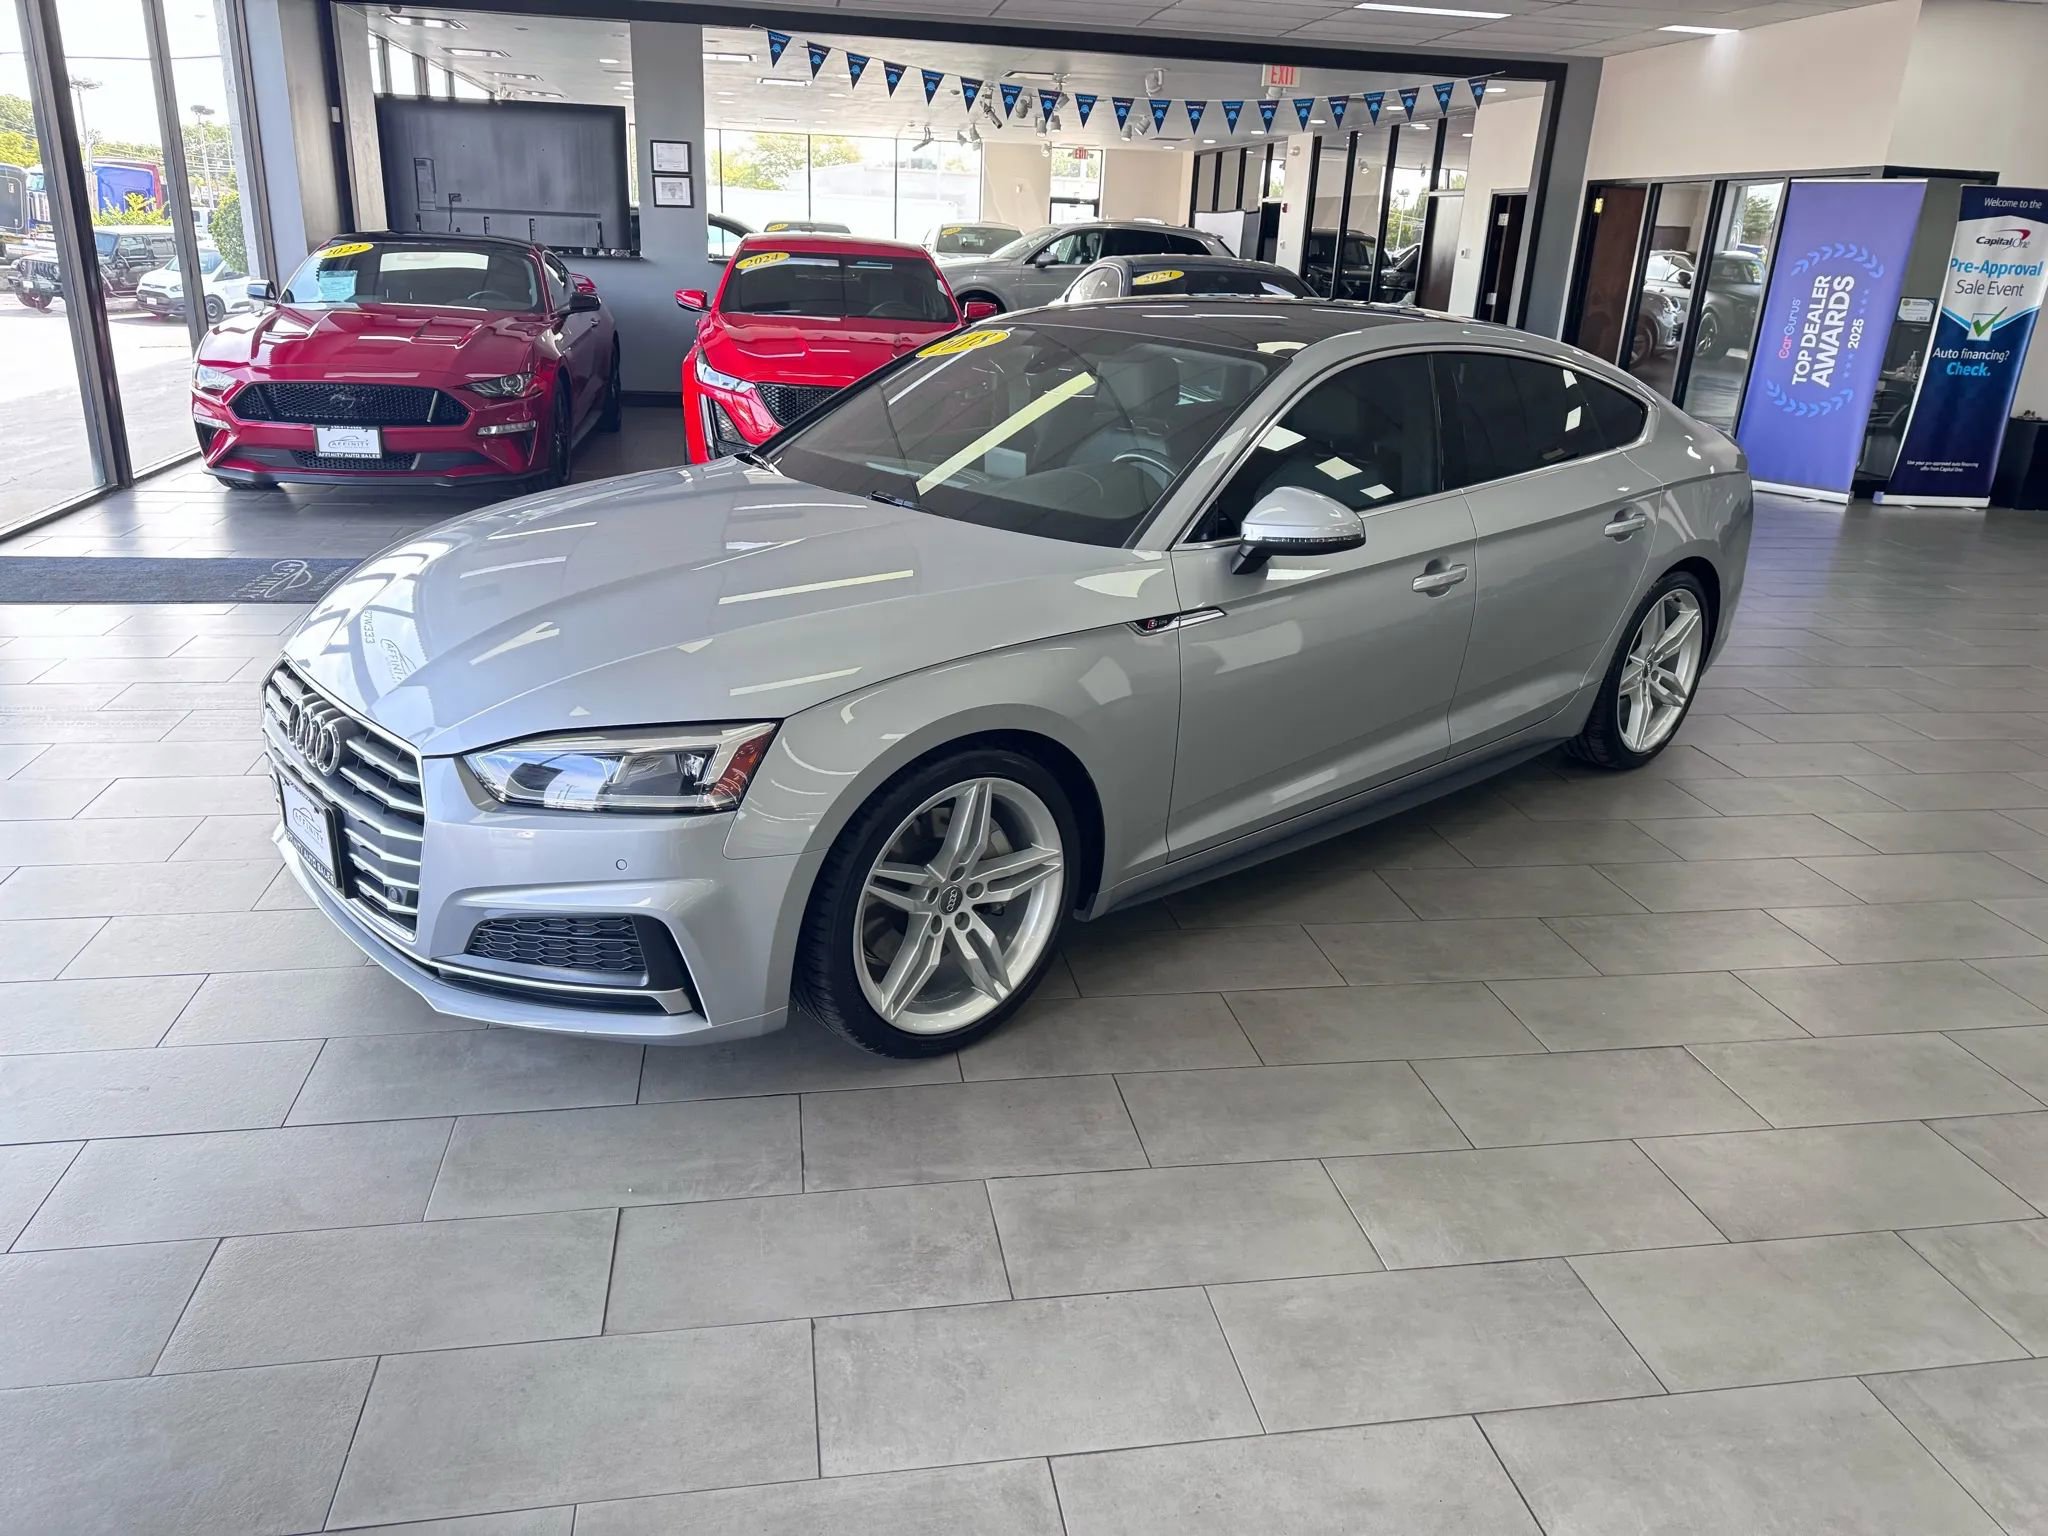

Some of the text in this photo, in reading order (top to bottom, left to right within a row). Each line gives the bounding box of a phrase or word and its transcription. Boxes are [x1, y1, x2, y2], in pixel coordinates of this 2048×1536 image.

[1271, 64, 1296, 85] EXIT
[1984, 197, 2042, 209] Welcome to the
[1950, 257, 2044, 278] Pre-Approval
[1954, 279, 2025, 297] Sale Event
[1779, 298, 1801, 359] CarGurus
[1791, 275, 1832, 385] TOP DEALER
[1811, 276, 1855, 388] AWARDS
[1847, 318, 1865, 349] 2025
[1932, 347, 2010, 363] Auto financing?
[1946, 361, 1991, 377] Check.
